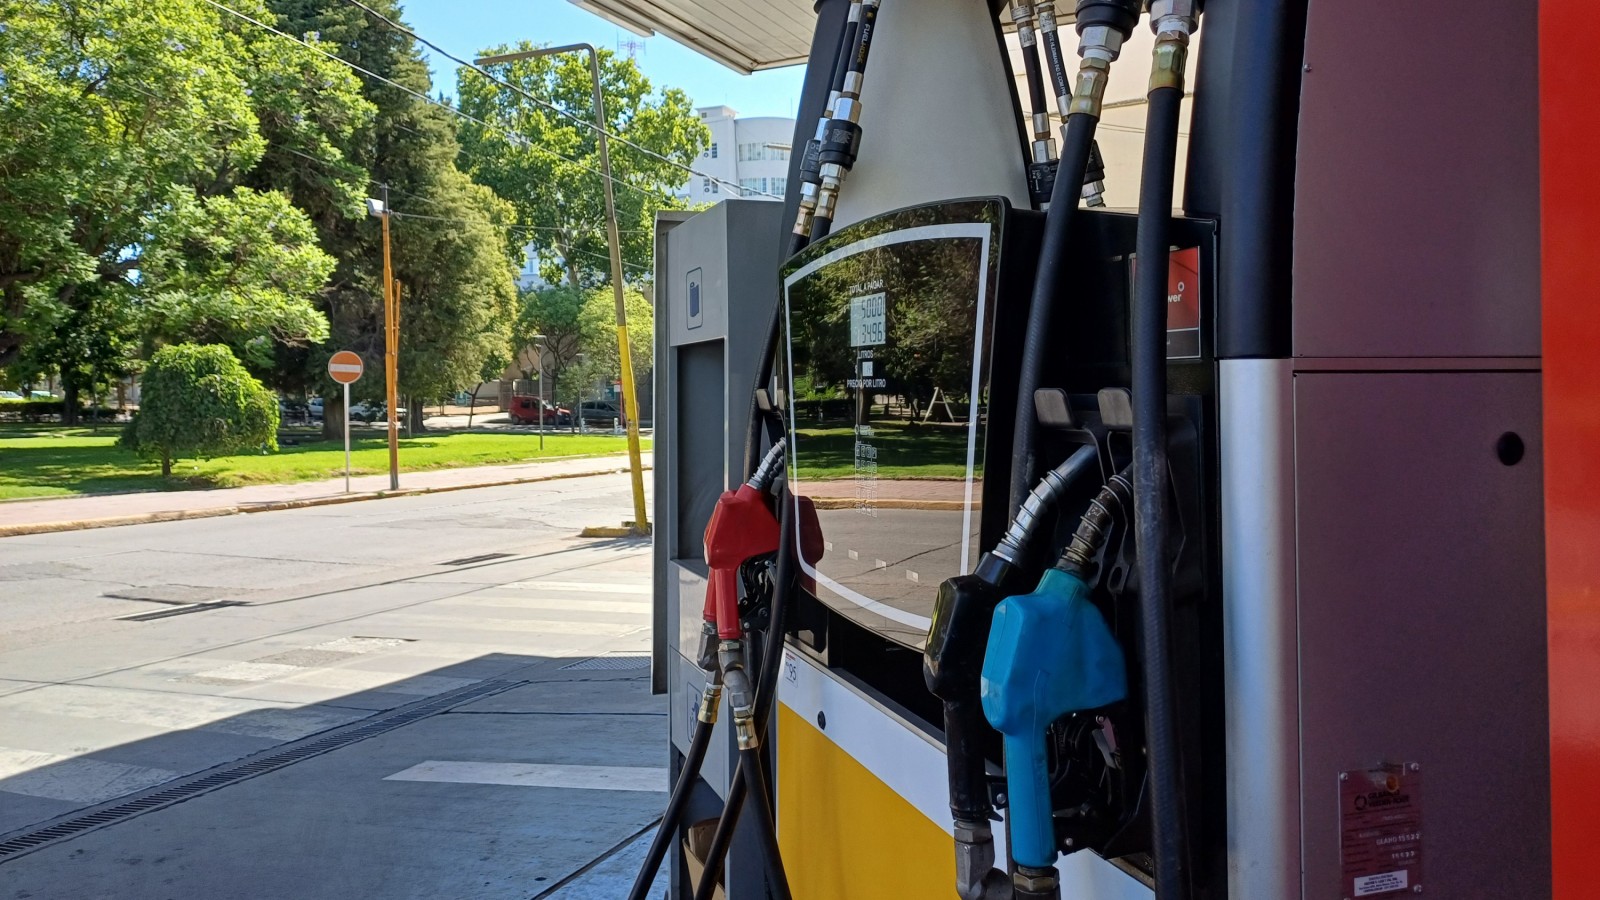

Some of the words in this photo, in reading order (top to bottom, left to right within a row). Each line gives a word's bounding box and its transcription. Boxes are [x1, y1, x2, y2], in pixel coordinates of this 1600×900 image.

[867, 279, 884, 291] PAGAR
[858, 350, 874, 359] LITROS
[847, 379, 862, 388] PRECIO
[863, 379, 872, 388] POR
[873, 379, 886, 388] LITRO
[789, 664, 797, 681] 95
